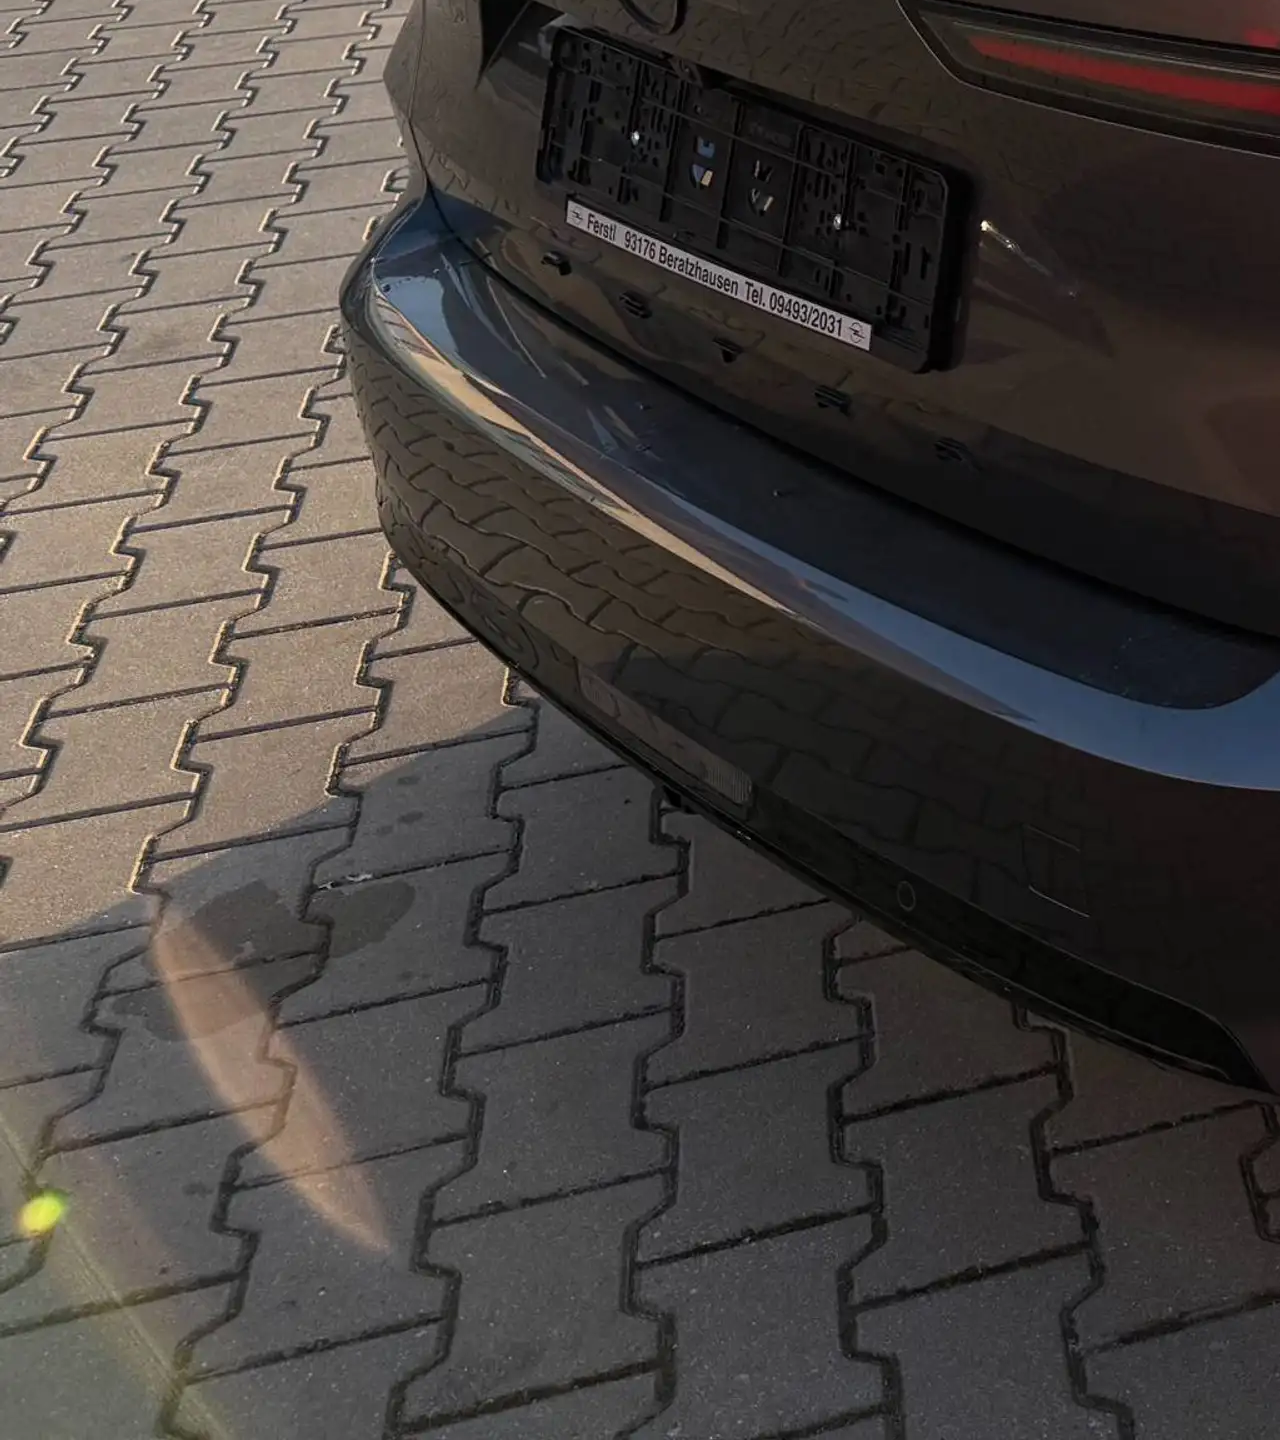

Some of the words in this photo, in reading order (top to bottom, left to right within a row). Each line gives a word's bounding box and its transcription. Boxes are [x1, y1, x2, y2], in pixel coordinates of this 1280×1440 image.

[587, 213, 616, 241] Ferstl
[624, 231, 656, 260] 93176
[658, 246, 739, 296] Beratzhausen
[745, 281, 766, 307] Tel.
[769, 292, 842, 336] 09493/2031
